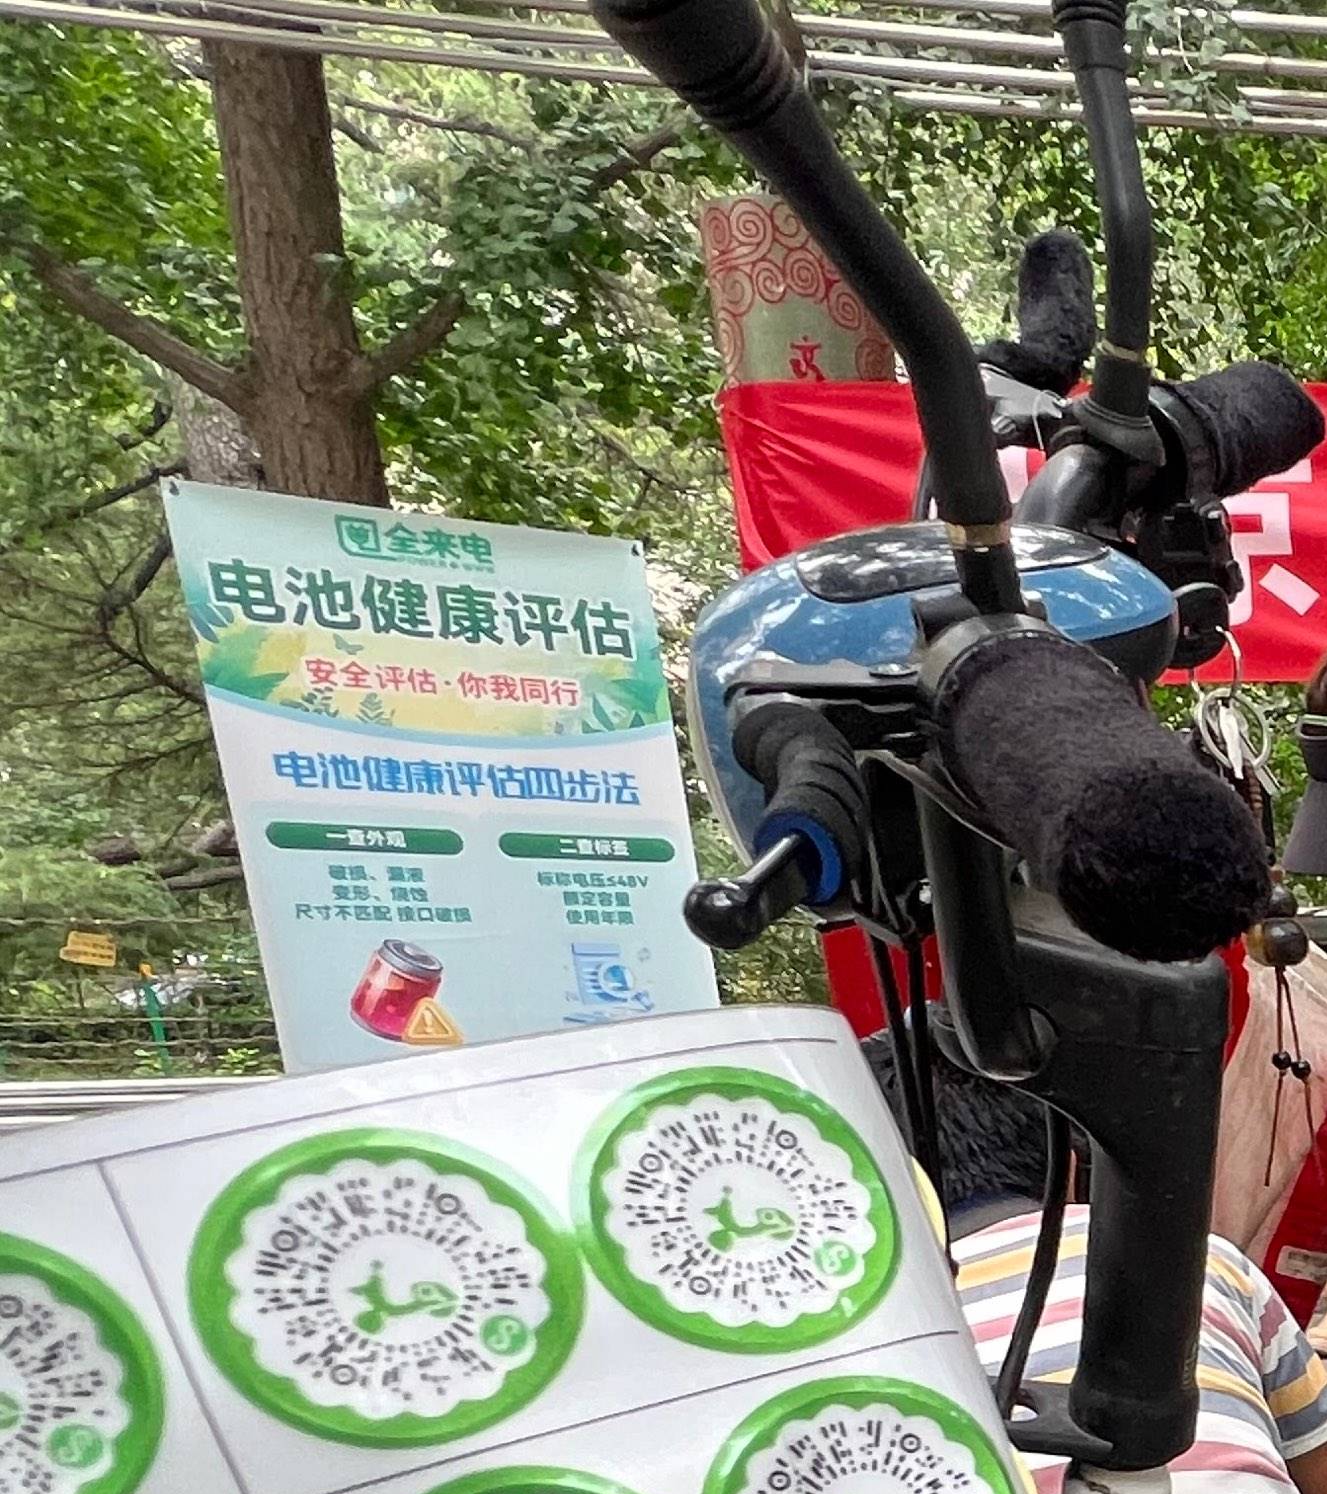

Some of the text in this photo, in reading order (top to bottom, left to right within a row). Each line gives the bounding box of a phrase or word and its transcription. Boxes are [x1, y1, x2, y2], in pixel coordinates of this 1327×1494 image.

[208, 559, 635, 658] 电池健康评估
[304, 658, 581, 707] 安全评估·你我同行
[272, 751, 641, 805] 电池健康评估四步法
